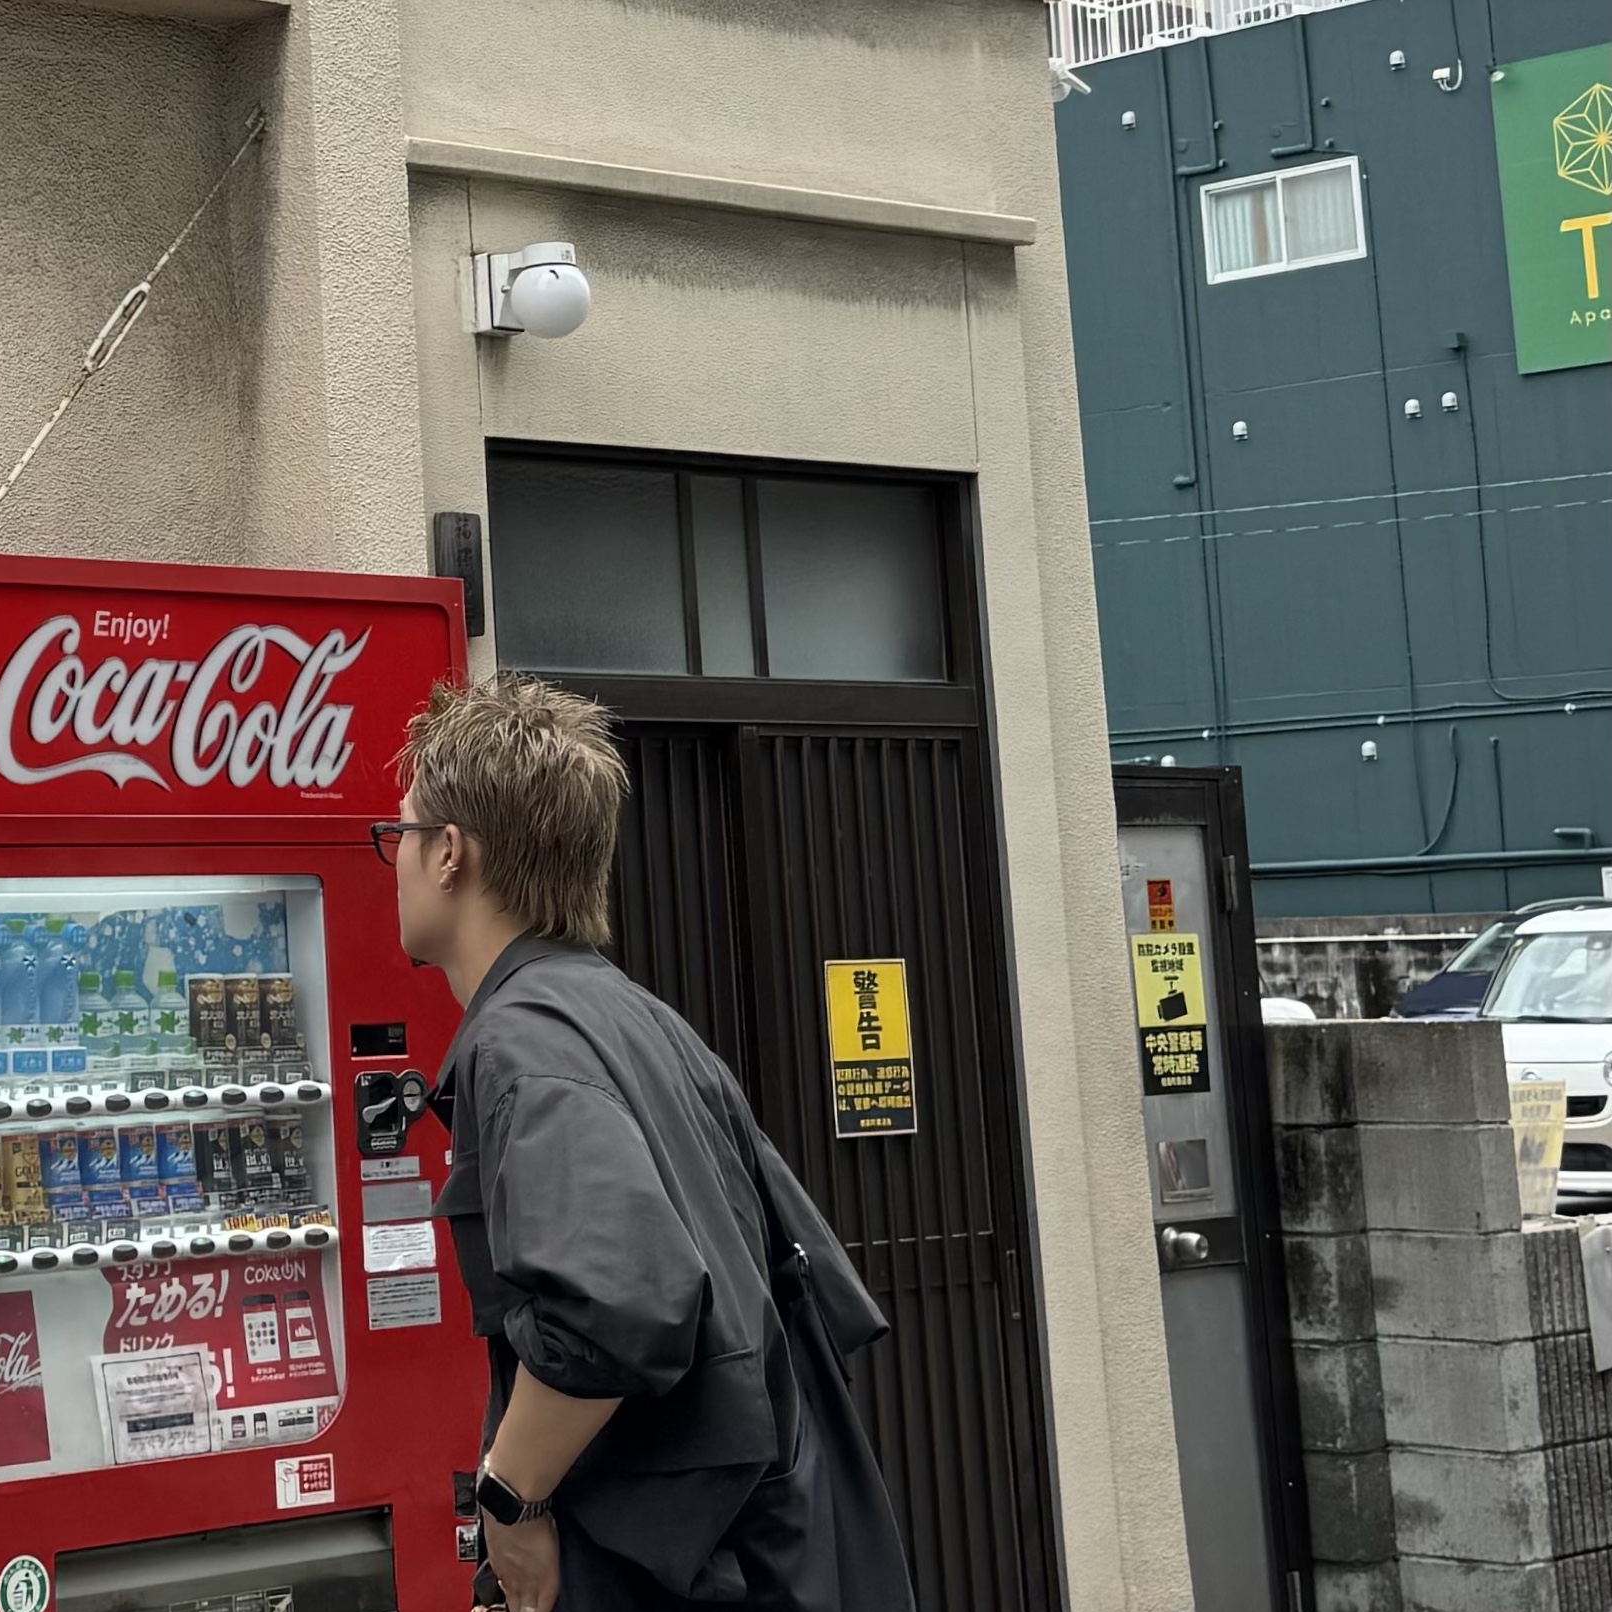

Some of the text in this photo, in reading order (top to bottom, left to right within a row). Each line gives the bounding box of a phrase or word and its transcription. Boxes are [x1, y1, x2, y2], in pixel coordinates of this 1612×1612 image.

[92, 609, 171, 647] Enjoy!
[852, 969, 883, 1051] 警告
[1145, 1030, 1203, 1053] 中央警察署
[115, 1268, 230, 1329] ためる!
